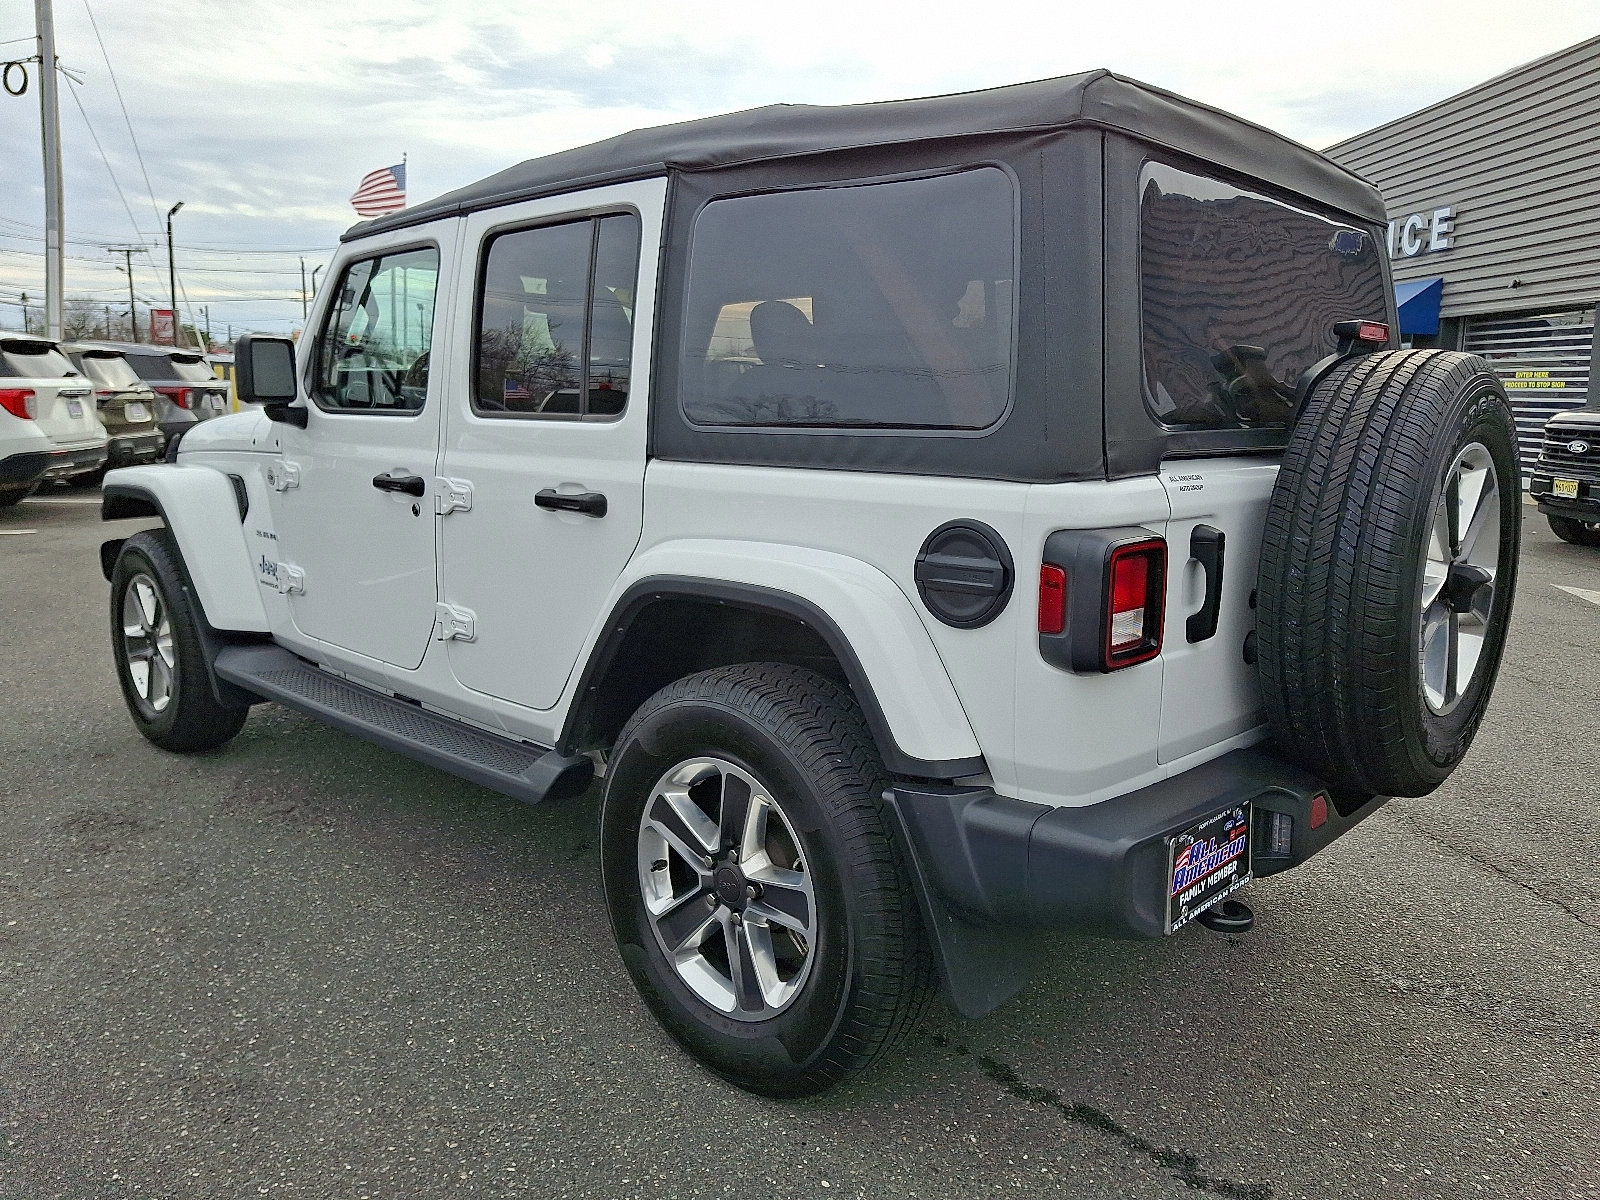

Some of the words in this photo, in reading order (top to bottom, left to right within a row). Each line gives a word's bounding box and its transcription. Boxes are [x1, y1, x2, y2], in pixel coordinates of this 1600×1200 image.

[1172, 834, 1247, 895] AMERICAN
[1189, 836, 1218, 867] ALL
[1172, 916, 1188, 932] ALL
[1188, 891, 1229, 921] AMERICAN
[1229, 877, 1250, 893] FORD
[1179, 880, 1207, 906] FAMILY
[1207, 861, 1238, 889] MEMBER
